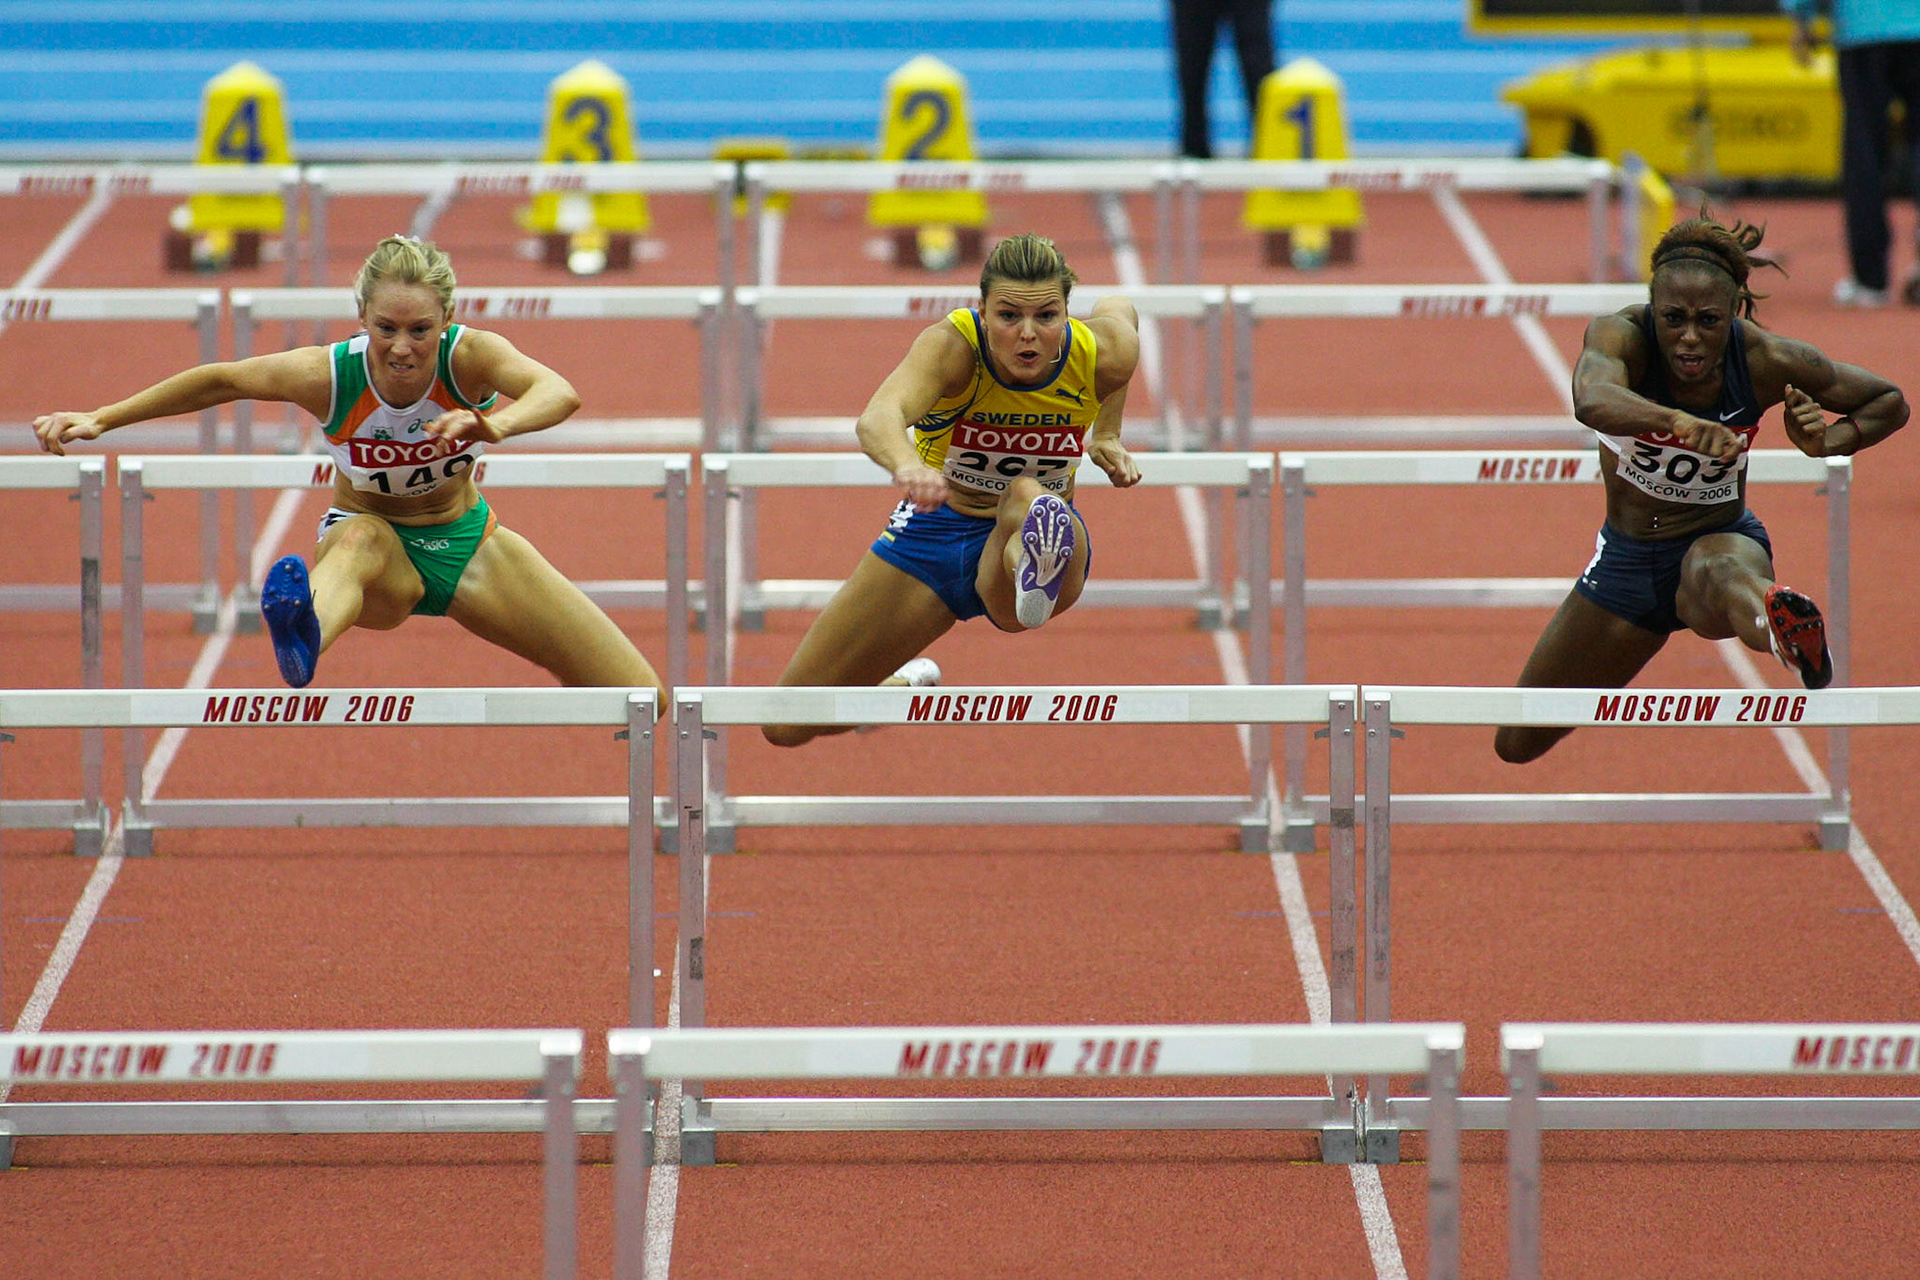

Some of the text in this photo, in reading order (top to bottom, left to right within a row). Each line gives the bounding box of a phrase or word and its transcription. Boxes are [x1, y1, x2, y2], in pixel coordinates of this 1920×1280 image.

[216, 97, 265, 164] 4
[565, 98, 611, 163] 3
[903, 91, 949, 161] 2
[1284, 94, 1314, 160] 1
[971, 412, 1072, 426] SWEDEN
[961, 424, 1080, 452] TOYOTA
[1478, 458, 1581, 480] MOSCOW
[1630, 441, 1738, 485] 303
[951, 471, 1010, 491] MOSCO
[1625, 466, 1690, 499] MOSCOW
[1699, 486, 1732, 500] 2006
[203, 695, 415, 722] MOSCOW 2006
[906, 695, 1118, 721] MOSCOW 2006
[1594, 695, 1807, 722] MOSCOW 2006
[11, 1043, 278, 1076] MOSCOW 2006
[898, 1039, 1161, 1076] MOSCOW 2006
[1794, 1036, 1920, 1068] MOSCO
